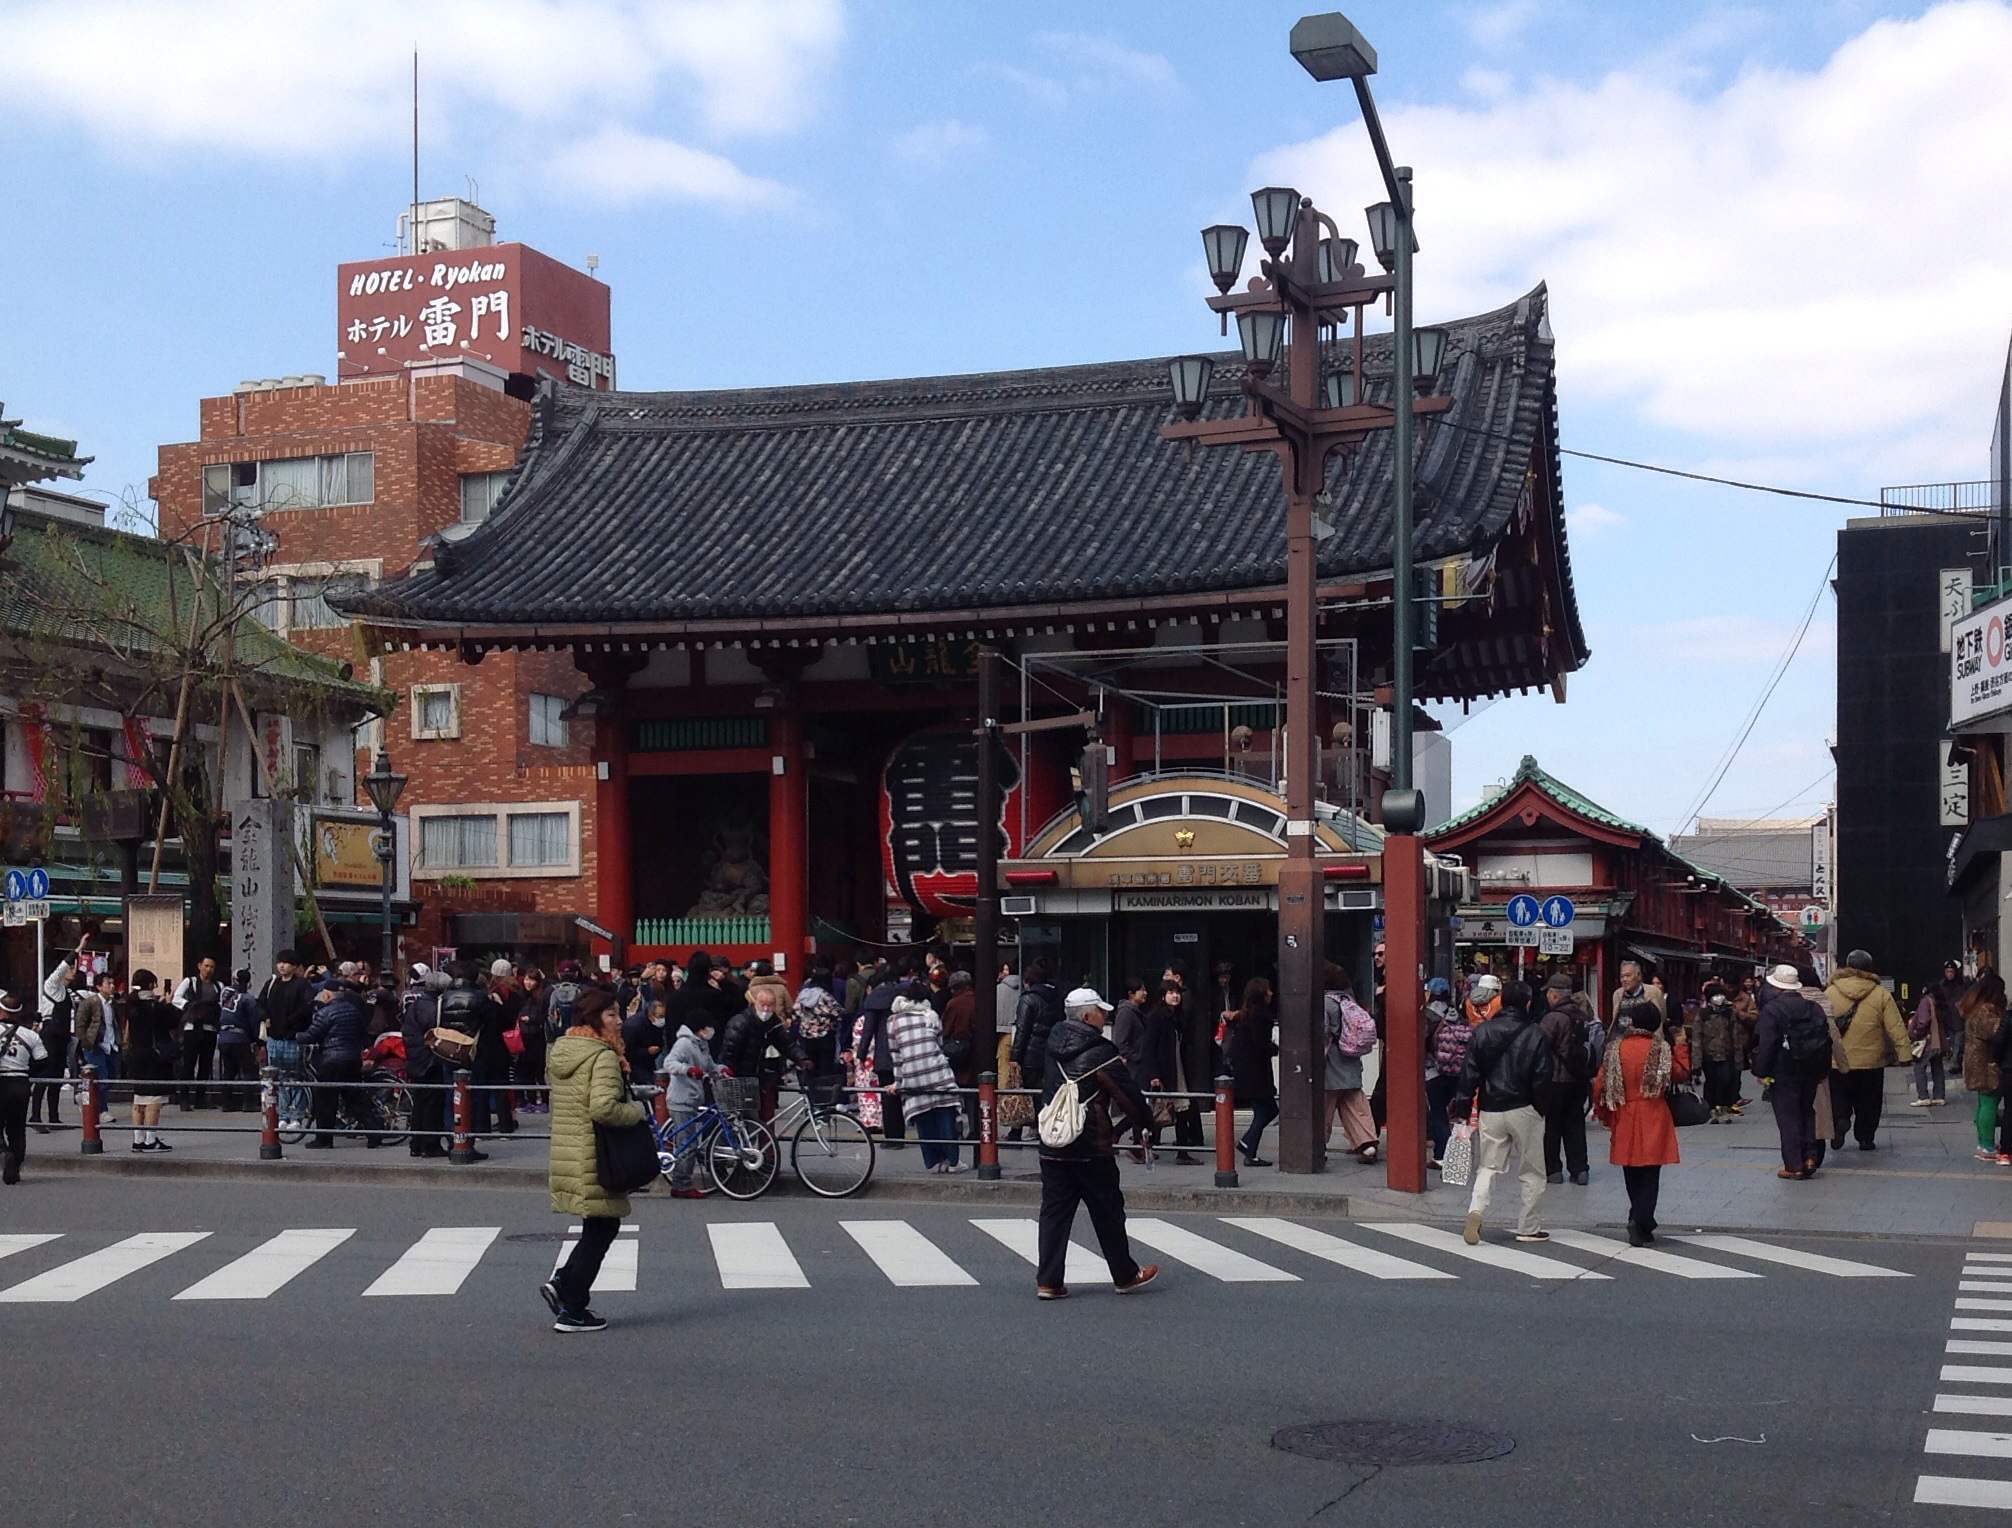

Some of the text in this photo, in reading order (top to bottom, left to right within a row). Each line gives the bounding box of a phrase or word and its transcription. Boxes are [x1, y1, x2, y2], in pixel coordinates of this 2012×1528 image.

[350, 261, 506, 296] HOTEL Ryokan
[1957, 626, 1983, 661] 地下鉄
[1957, 654, 1982, 680] SUBWAY
[1177, 863, 1261, 884] 雷門交番
[1127, 895, 1261, 907] KAMINARIMON KOBAN
